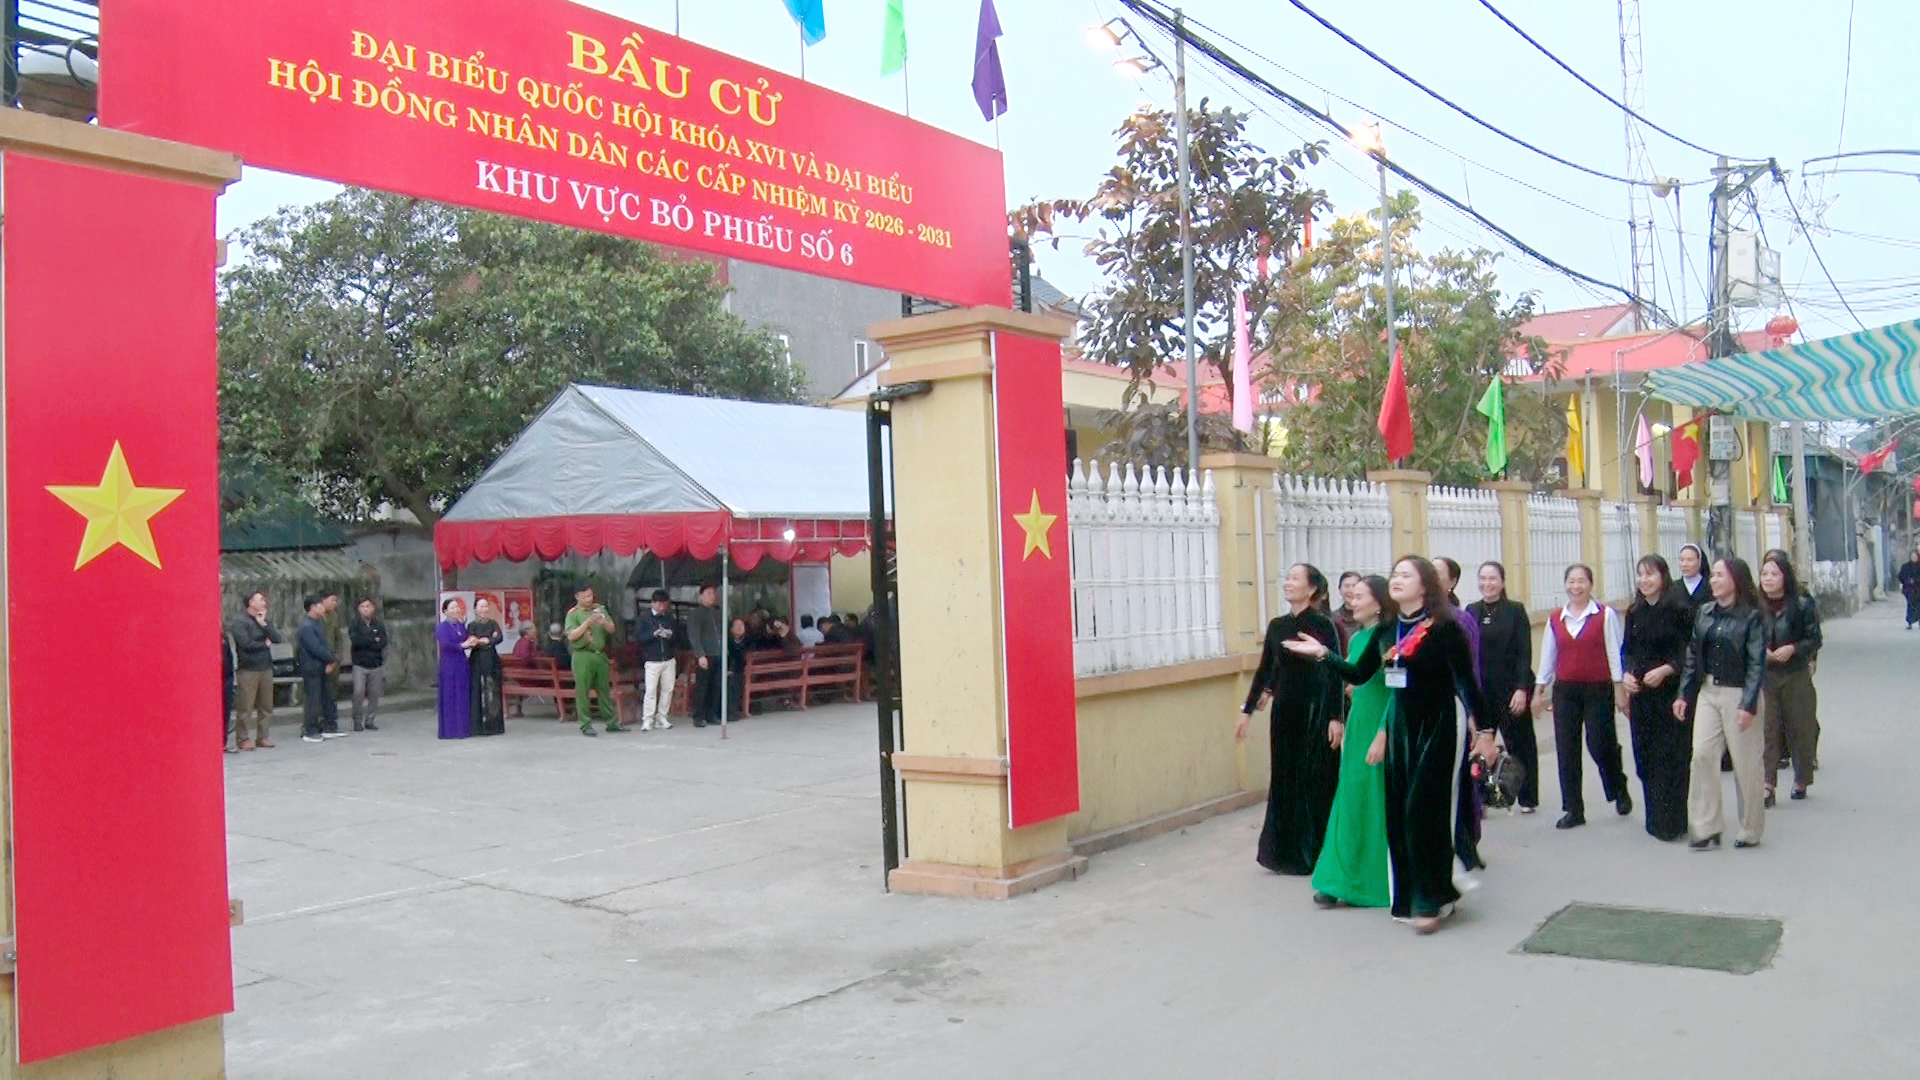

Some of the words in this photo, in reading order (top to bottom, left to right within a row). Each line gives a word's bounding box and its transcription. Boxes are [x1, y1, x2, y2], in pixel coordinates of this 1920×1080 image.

[351, 30, 417, 72] ĐẠI
[426, 51, 509, 95] BIỂU
[517, 77, 604, 120] QUỐC
[611, 102, 662, 138] HỘI
[669, 115, 743, 158] KHÓA
[745, 139, 787, 170] XVI
[790, 151, 821, 180] VÀ
[825, 162, 863, 192] ĐẠI
[866, 172, 913, 205] BIỂU
[566, 31, 692, 98] BẦU
[710, 77, 783, 126] CỬ
[267, 57, 343, 104] HỘI
[351, 77, 458, 128] ĐỒNG
[466, 107, 559, 152] NHÂN
[567, 131, 628, 169] DÂN
[636, 149, 690, 182] CÁC
[696, 162, 746, 196] CẤP
[751, 179, 828, 217] NHIỆM
[832, 197, 861, 224] KỲ
[864, 209, 904, 236] 2026
[917, 223, 953, 249] 2031
[475, 159, 560, 204] KHU
[567, 180, 641, 222] VỰC
[650, 194, 695, 233] BỎ
[703, 210, 793, 253] PHIẾU
[801, 226, 834, 262] SỐ
[840, 243, 854, 267] 6
